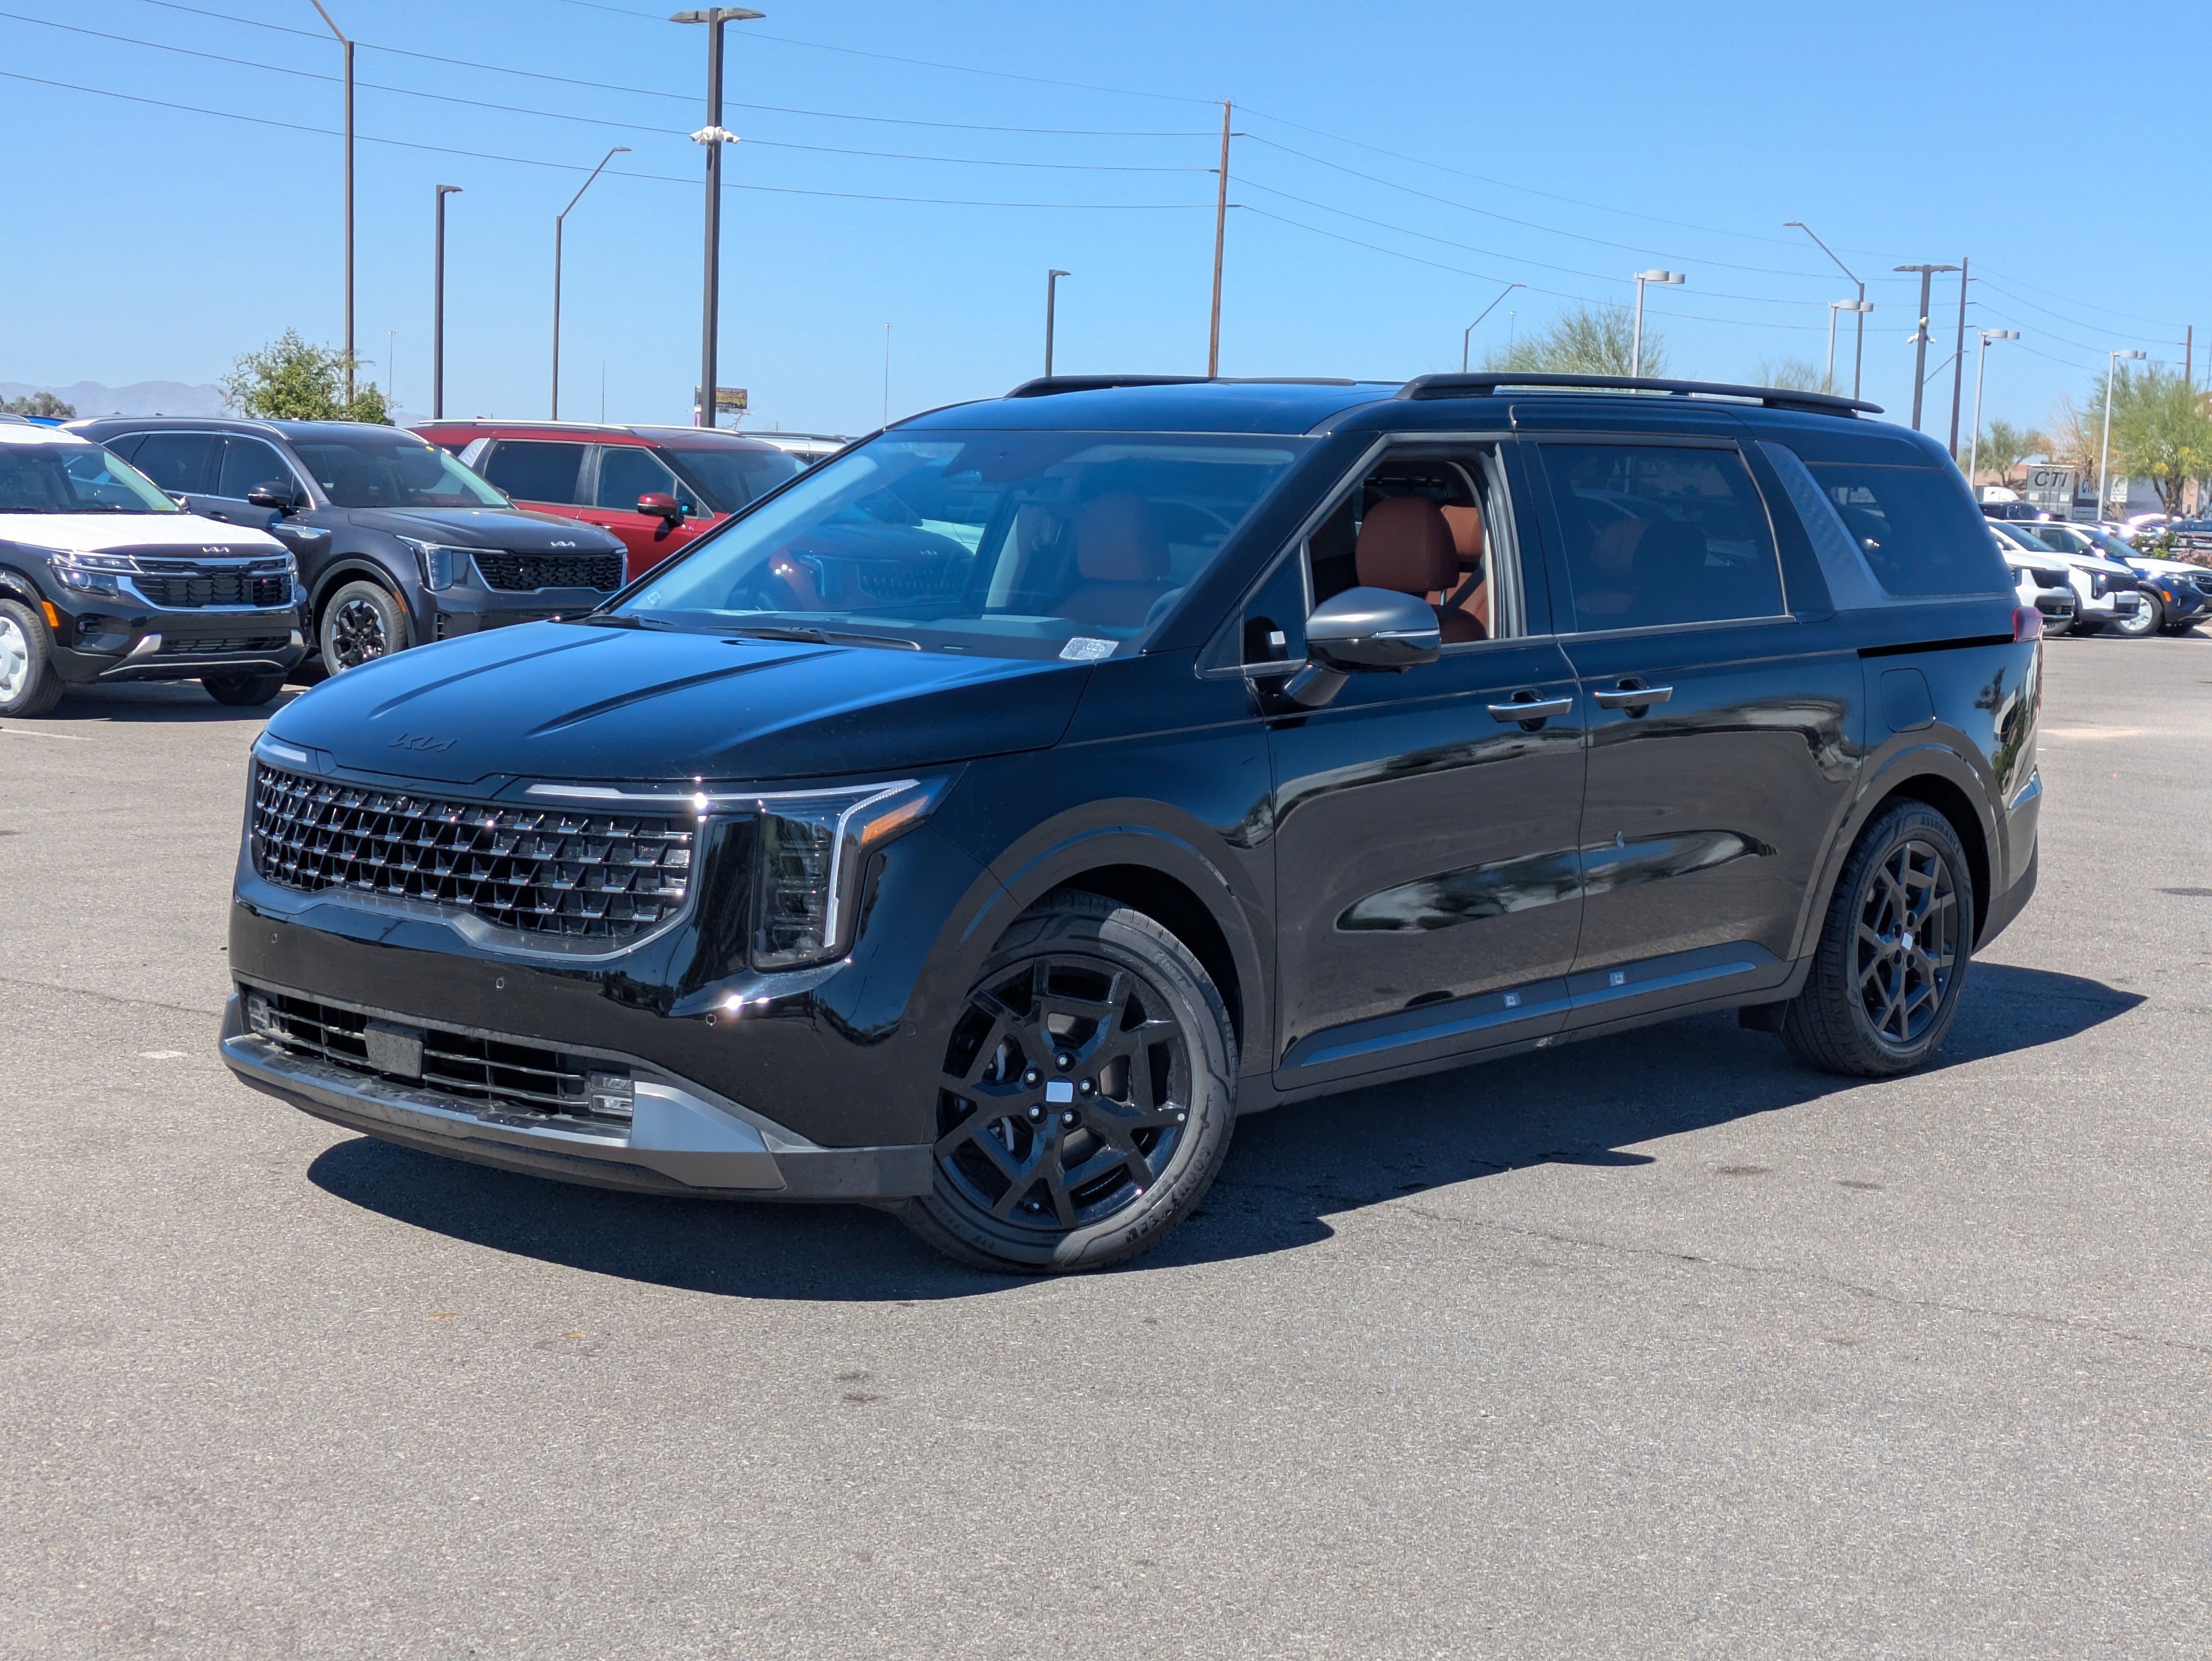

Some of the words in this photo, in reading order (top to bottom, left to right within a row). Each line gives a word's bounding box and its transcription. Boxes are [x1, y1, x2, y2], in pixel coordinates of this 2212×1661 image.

[2035, 471, 2068, 487] CTI
[388, 733, 457, 753] KIA
[1126, 1146, 1211, 1242] GOODYEAR
